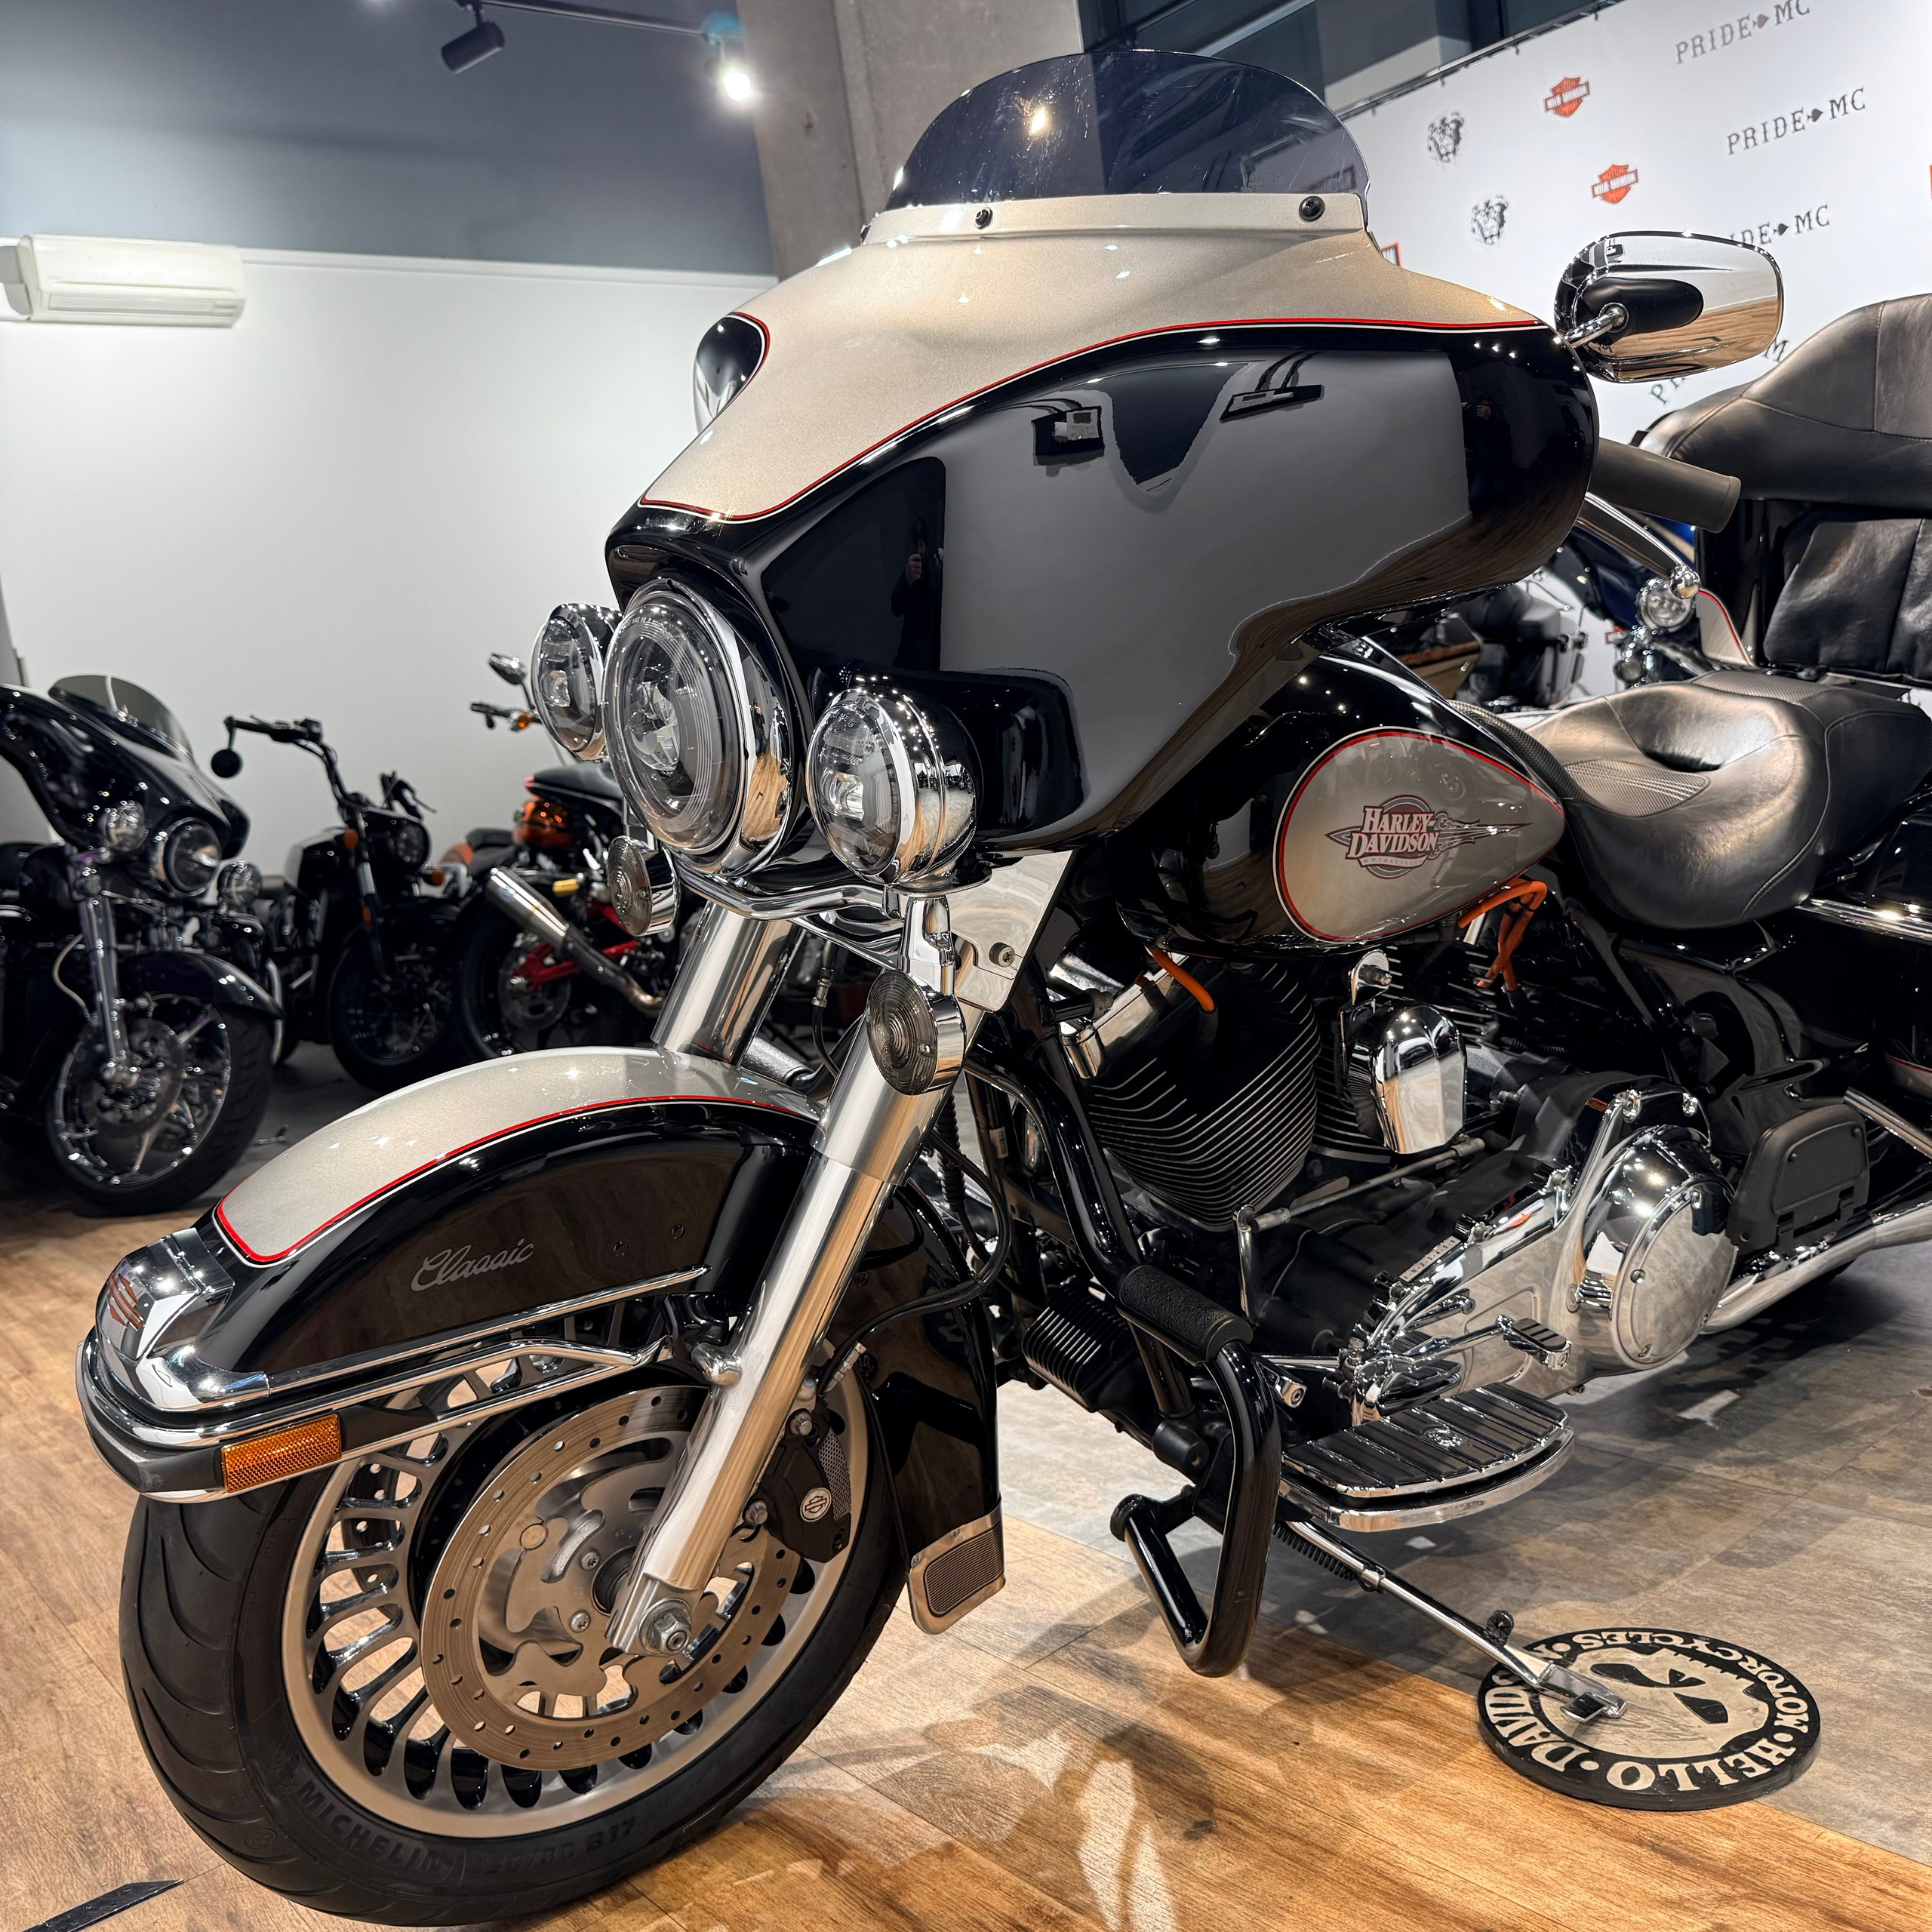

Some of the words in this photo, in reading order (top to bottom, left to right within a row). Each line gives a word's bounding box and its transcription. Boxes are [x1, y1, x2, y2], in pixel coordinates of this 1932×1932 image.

[1675, 14, 1752, 65] PRIDE
[1773, 0, 1810, 26] MC
[1726, 107, 1807, 156] PRIDE
[1829, 87, 1866, 120] MC
[1793, 204, 1830, 235] MC
[1346, 831, 1440, 858] DAVIDSON
[1361, 807, 1437, 834] HARLEY-
[411, 1238, 534, 1292] Classic
[1572, 1631, 1810, 1734] MOTORCYCLES
[1606, 1737, 1797, 1792] HELLO
[297, 1778, 445, 1875] MICHELIN
